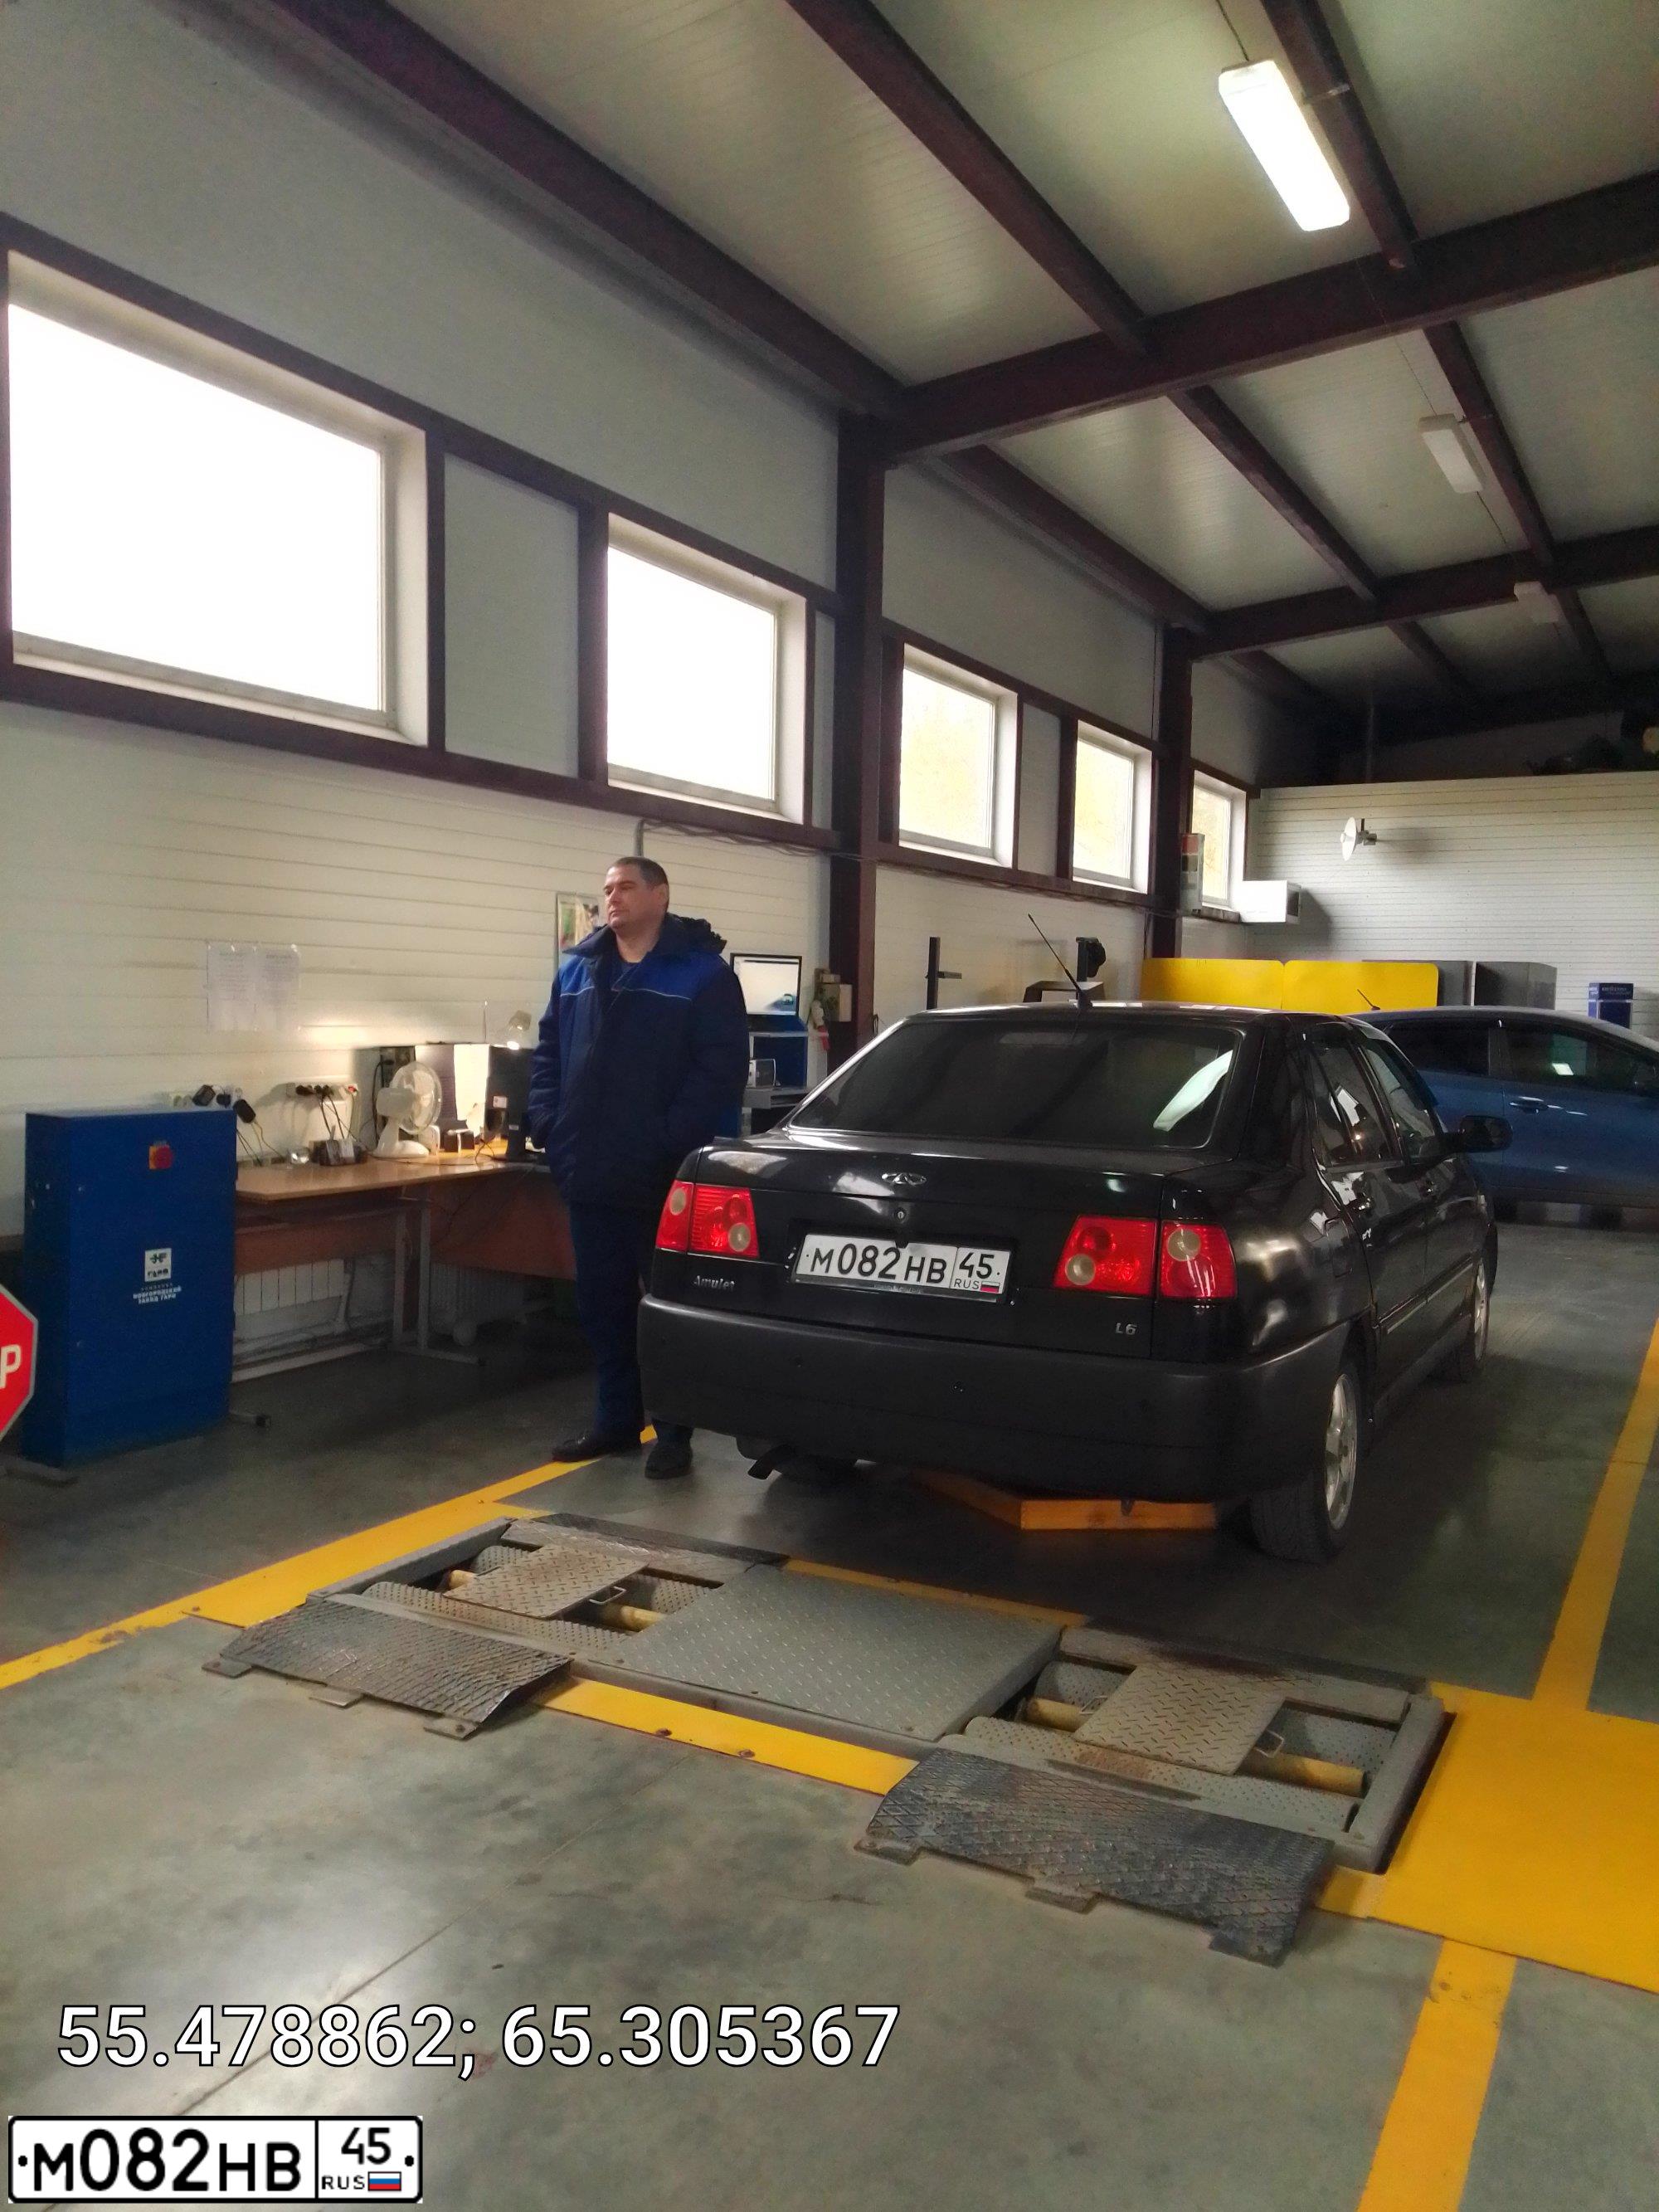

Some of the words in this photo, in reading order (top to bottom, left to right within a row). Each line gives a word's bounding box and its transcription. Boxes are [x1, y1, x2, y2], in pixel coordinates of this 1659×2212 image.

[810, 1244, 946, 1284] М082НВ
[959, 1252, 995, 1279] 45
[953, 1279, 980, 1290] RUS
